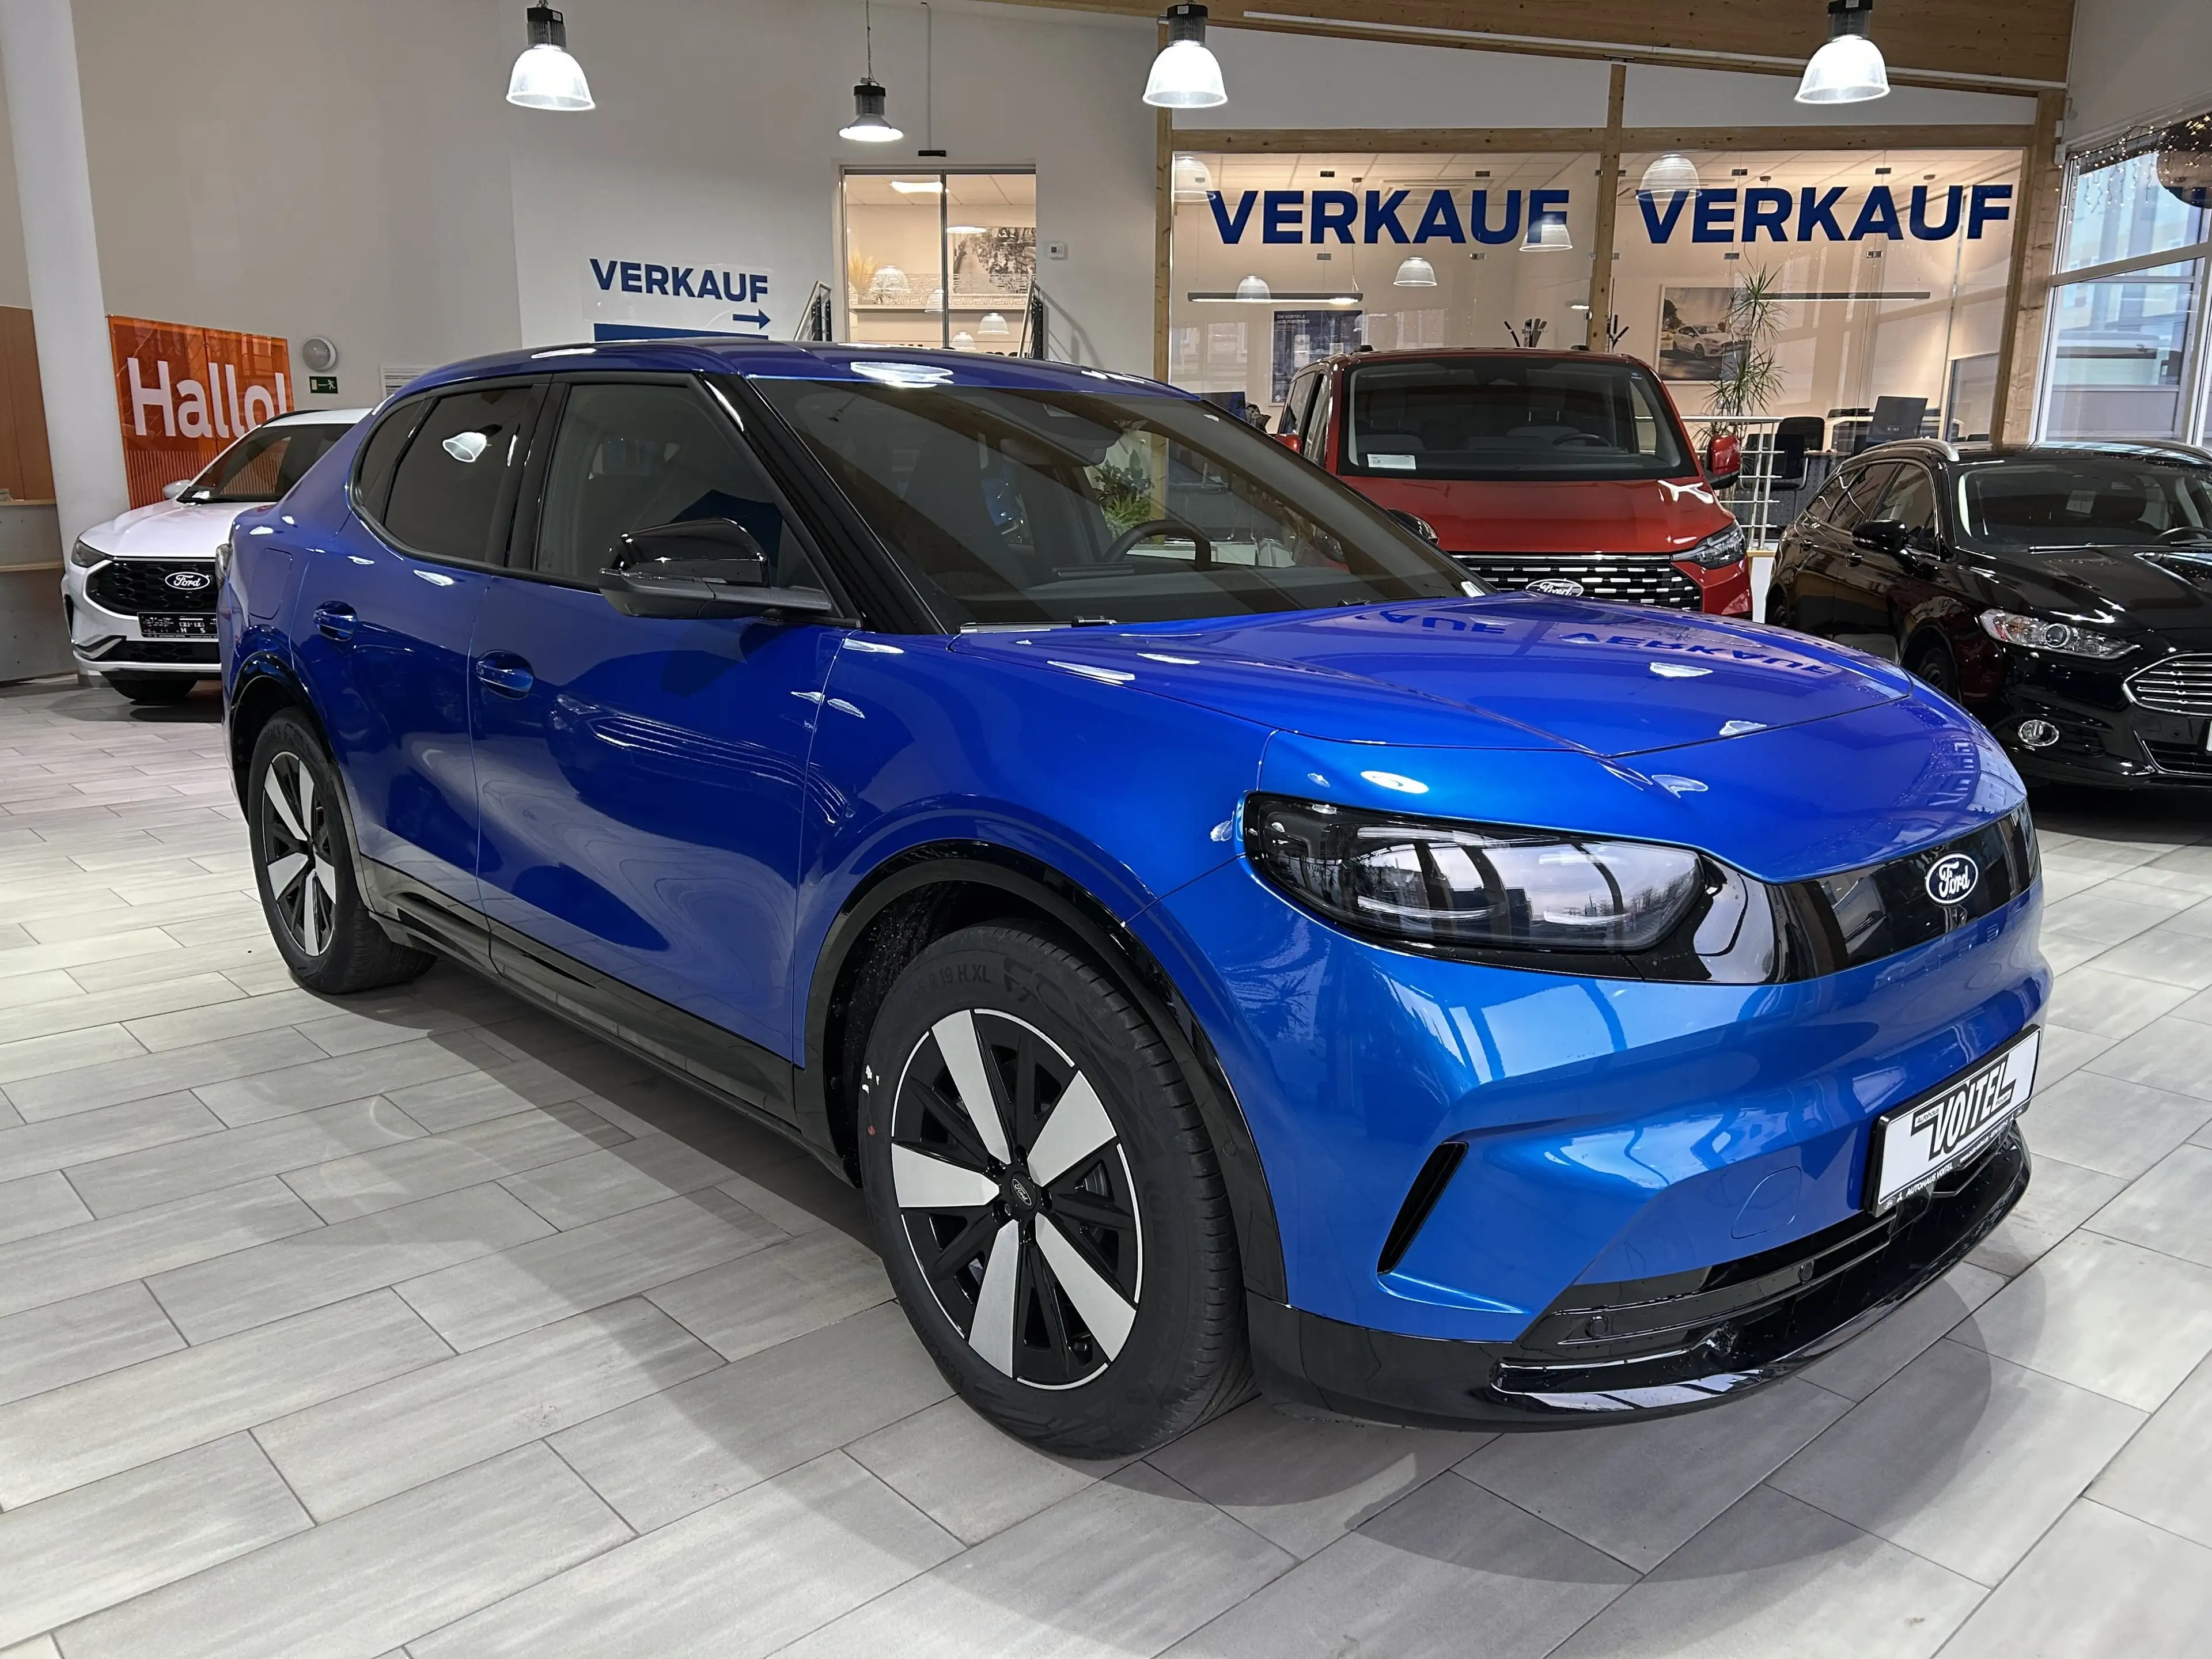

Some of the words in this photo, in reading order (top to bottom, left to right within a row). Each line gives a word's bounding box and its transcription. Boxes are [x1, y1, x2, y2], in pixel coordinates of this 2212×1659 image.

[1207, 190, 1569, 245] VERKAUF
[1635, 184, 2013, 244] VERKAUF
[589, 258, 768, 303] VERKAUF
[174, 574, 201, 586] Ford
[1938, 860, 1971, 898] Ford
[1927, 1061, 2011, 1153] VOITEL
[1906, 1172, 1936, 1197] AUTOHAUS
[1936, 1162, 1953, 1179] VOITEL
